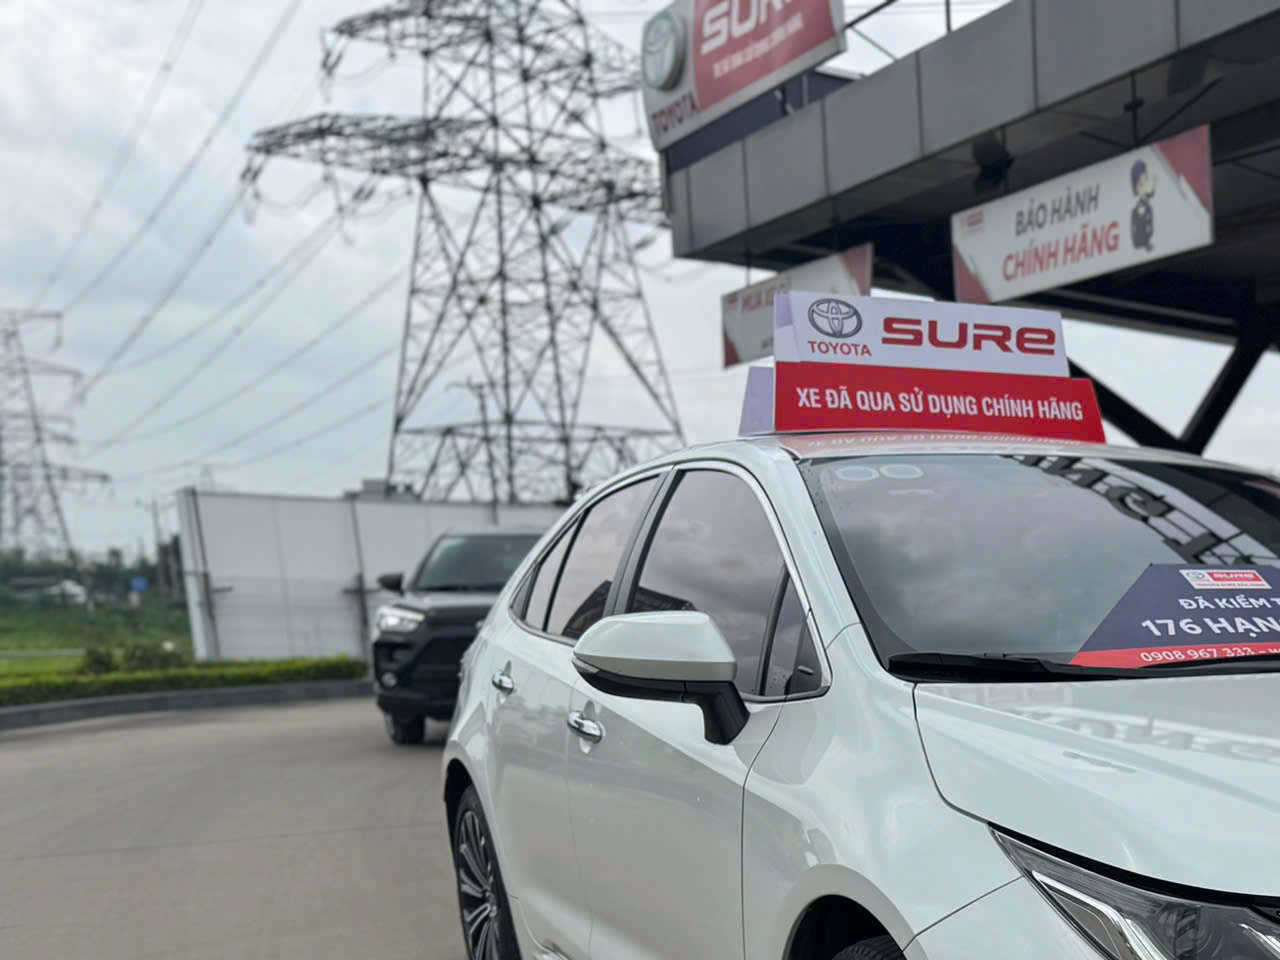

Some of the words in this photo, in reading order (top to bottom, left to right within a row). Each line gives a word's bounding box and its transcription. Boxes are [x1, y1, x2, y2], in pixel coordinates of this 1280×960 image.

[701, 0, 792, 56] SU
[1015, 197, 1048, 237] BẢO
[1051, 184, 1099, 219] HÀNH
[1002, 238, 1058, 282] CHÍNH
[1063, 221, 1121, 266] HÃNG
[808, 340, 872, 357] TOYOTA
[881, 316, 1056, 356] SURE
[796, 387, 821, 408] XE
[826, 385, 851, 409] ĐÃ
[856, 390, 895, 412] QUA
[899, 387, 925, 414] SỬ
[928, 393, 978, 418] DỤNG
[981, 393, 1034, 419] CHÍNH
[1038, 396, 1083, 421] HÃNG
[1178, 595, 1214, 609] ĐÃ
[1219, 594, 1272, 609] KIỂM
[1141, 618, 1202, 637] 176
[1140, 650, 1185, 663] 0908
[1187, 648, 1218, 660] 967
